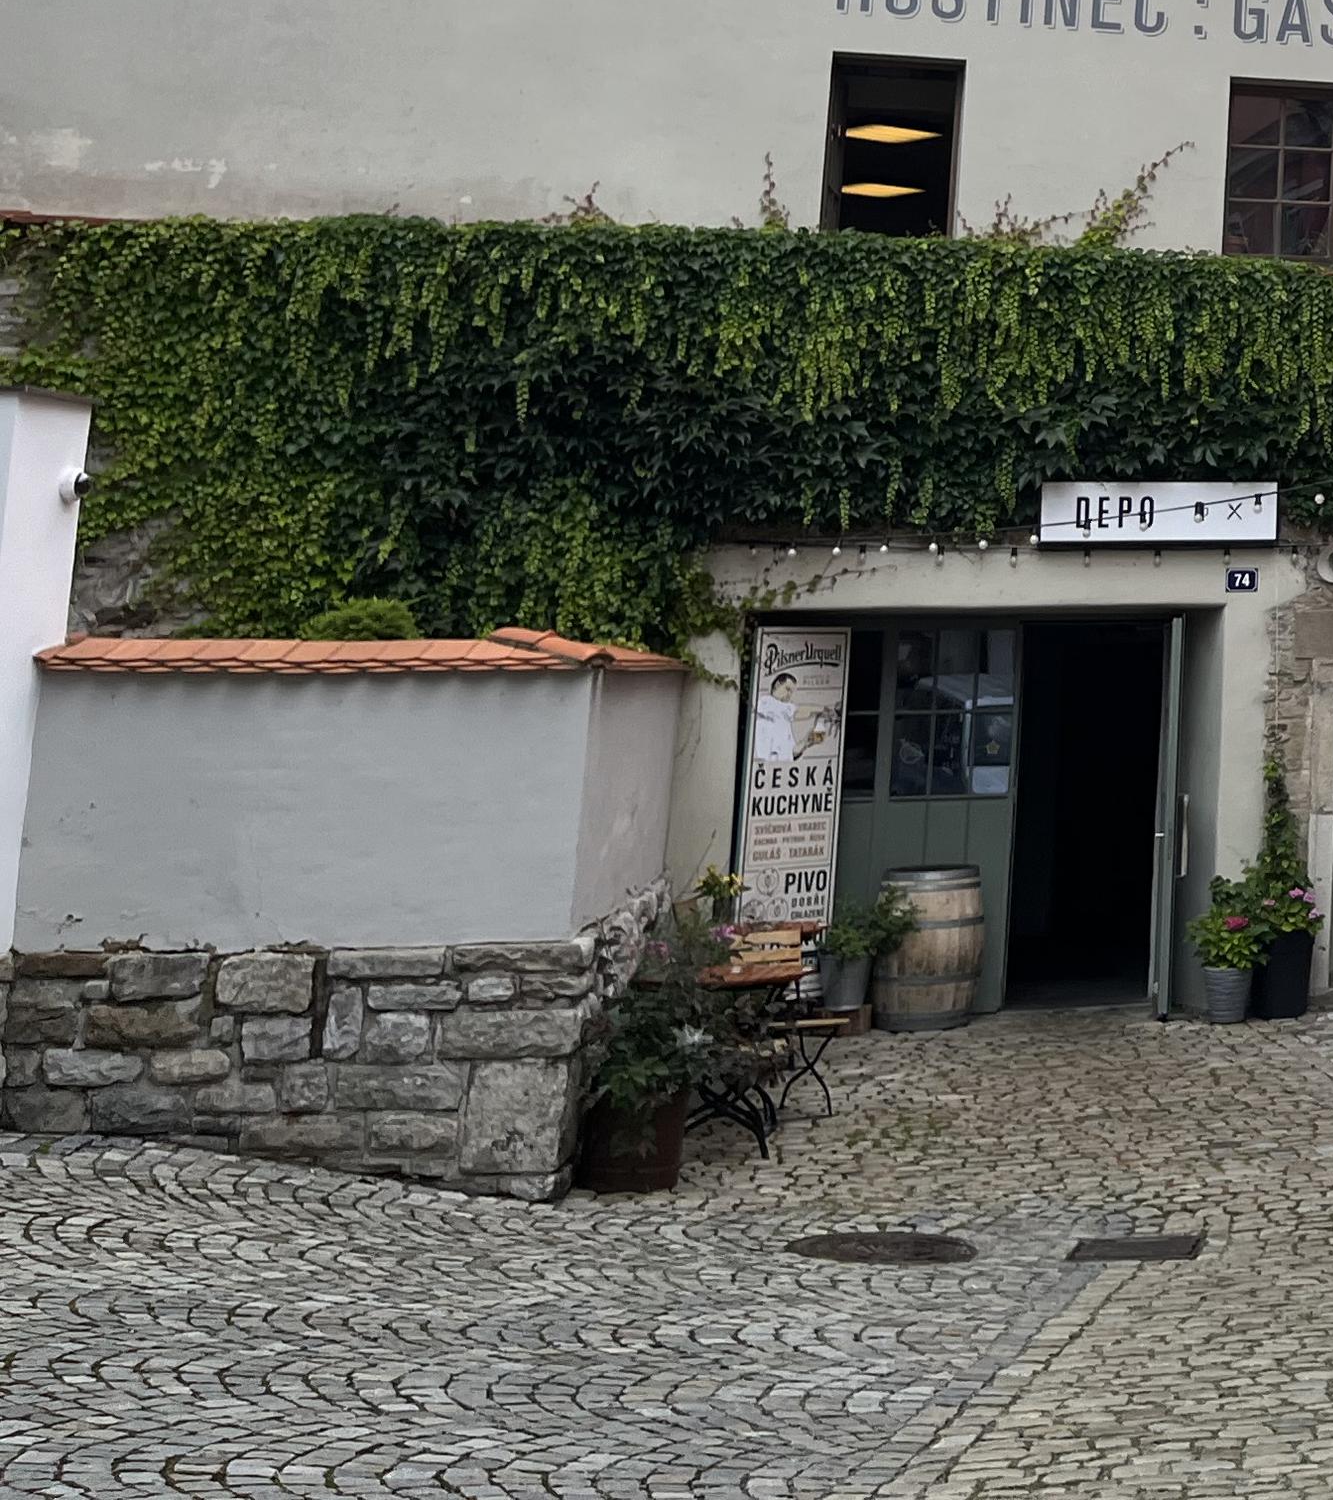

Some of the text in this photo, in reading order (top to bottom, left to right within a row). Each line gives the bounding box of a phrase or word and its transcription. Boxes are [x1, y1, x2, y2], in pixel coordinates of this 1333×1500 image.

[1076, 496, 1154, 528] DEPO
[1234, 574, 1250, 587] 74
[764, 643, 805, 677] Pilsner
[755, 759, 833, 789] ČESKÁ
[752, 787, 832, 816] KUCHYNĚ
[784, 869, 827, 894] PIVO
